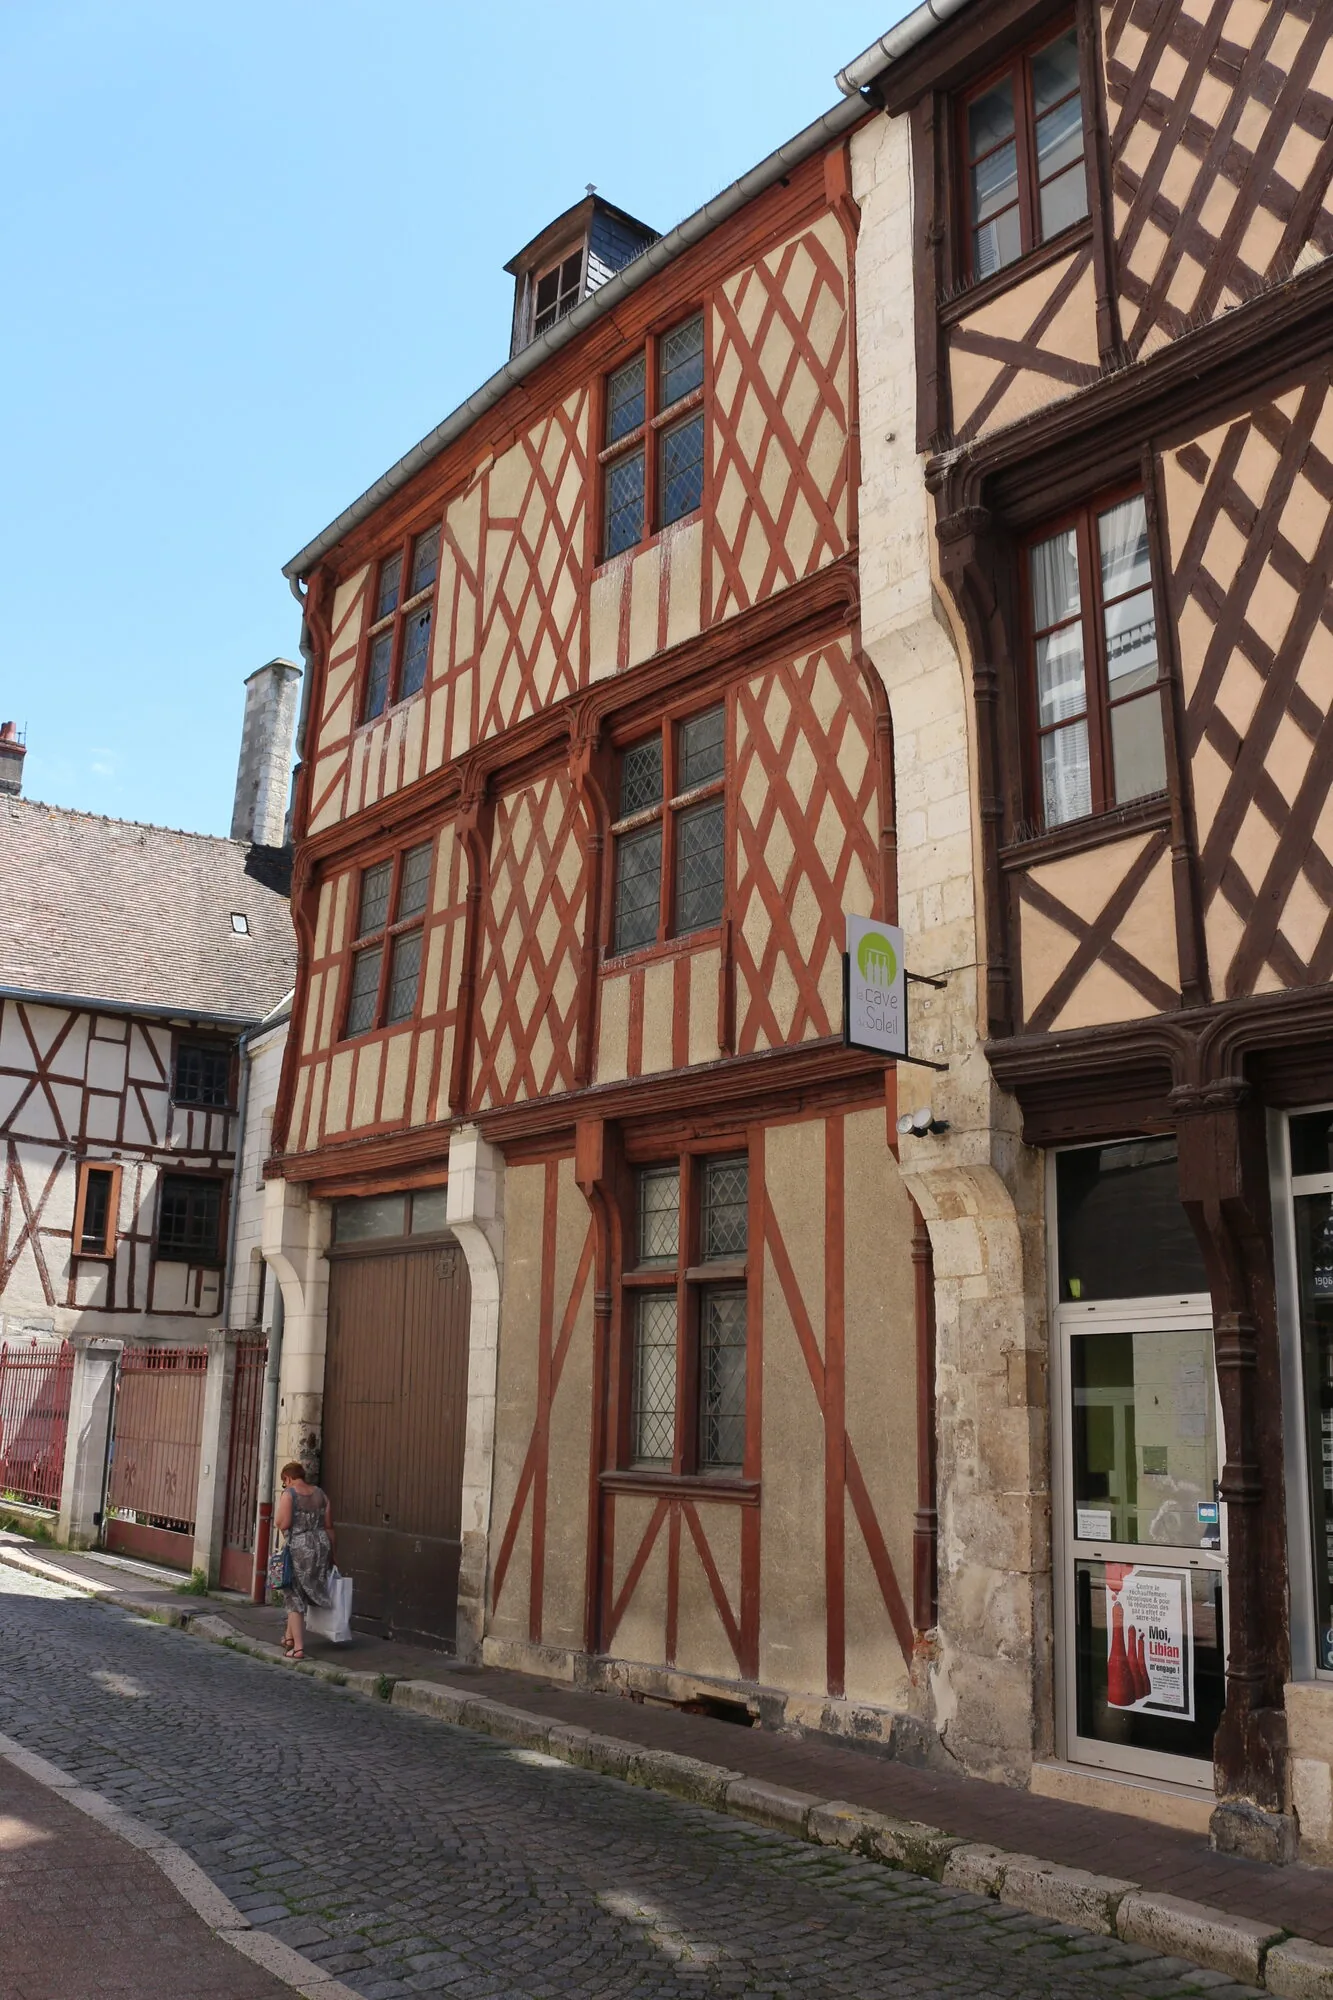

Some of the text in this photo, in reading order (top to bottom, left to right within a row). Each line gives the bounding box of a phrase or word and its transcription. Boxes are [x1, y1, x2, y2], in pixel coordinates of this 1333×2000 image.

[866, 1005, 898, 1035] Soleil
[1149, 1625, 1171, 1643] Moi,
[1149, 1641, 1179, 1658] Libian
[1150, 1664, 1176, 1674] m'engage
